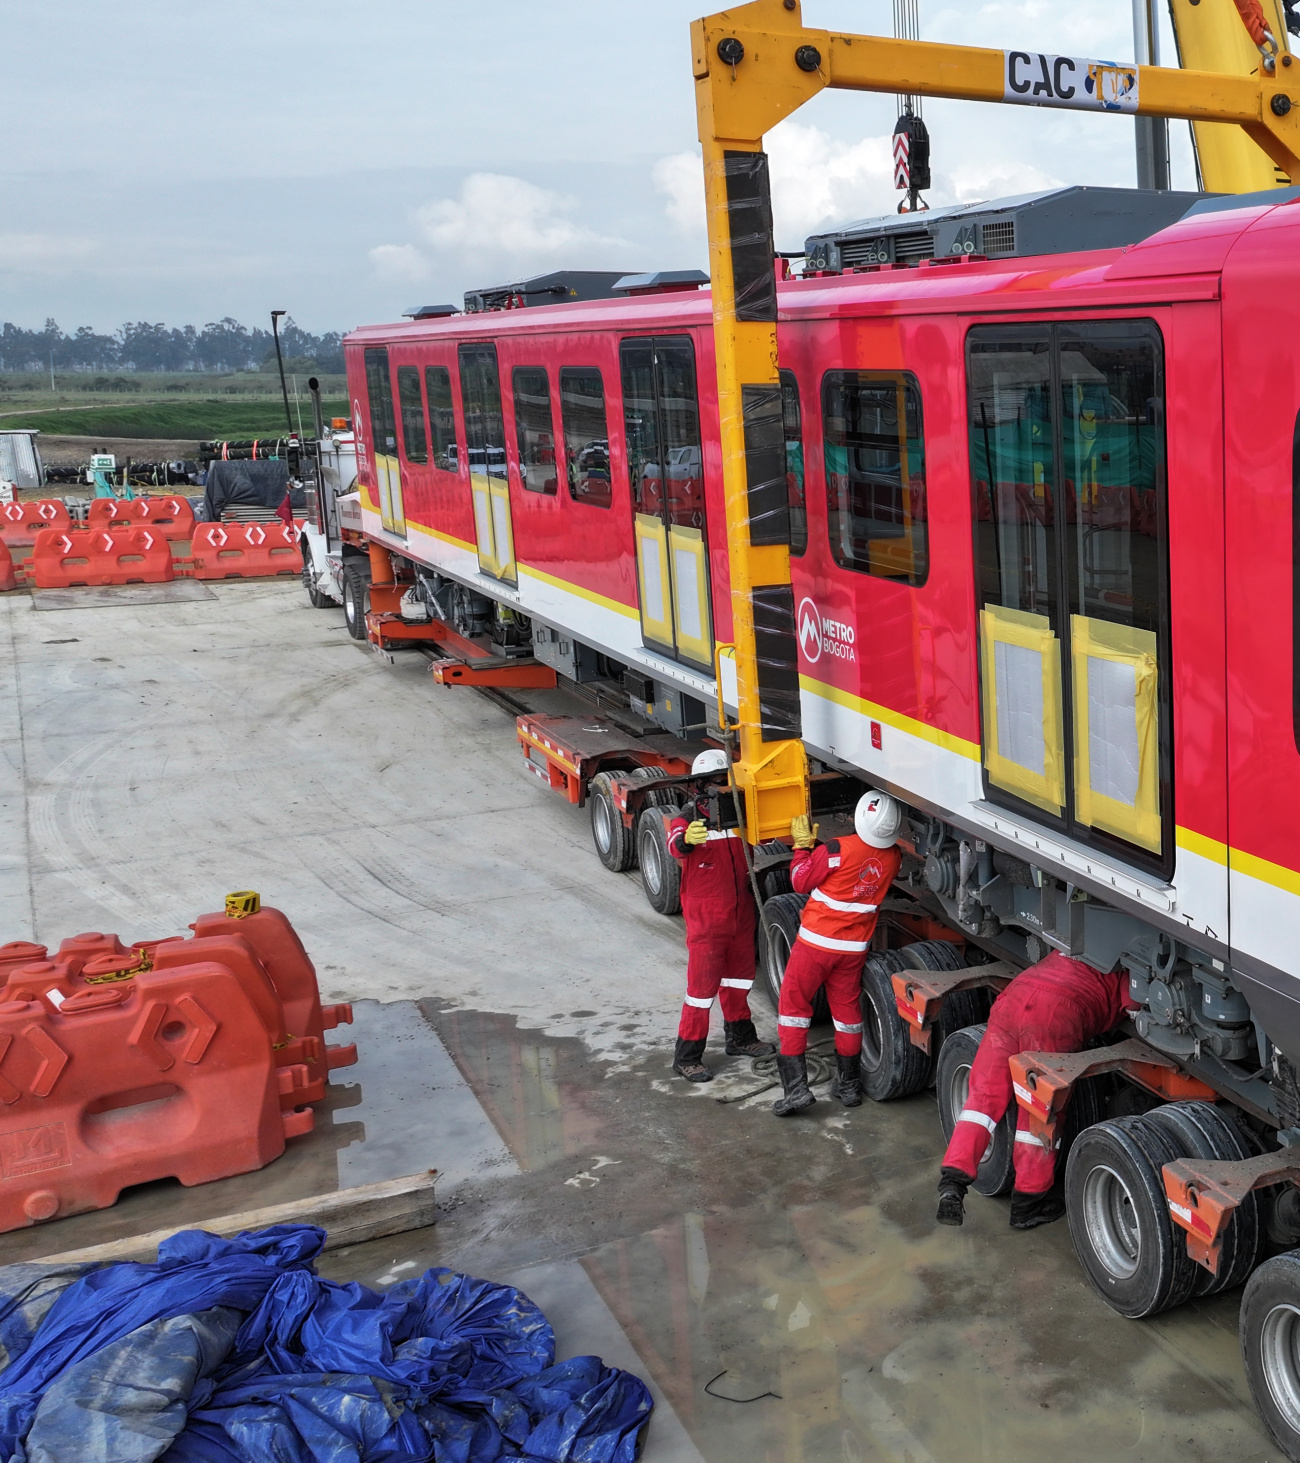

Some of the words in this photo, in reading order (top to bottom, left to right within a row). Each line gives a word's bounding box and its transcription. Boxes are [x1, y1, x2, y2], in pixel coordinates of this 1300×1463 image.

[1008, 51, 1076, 100] CAC
[822, 616, 855, 644] METRO
[823, 637, 856, 663] BOGOTA
